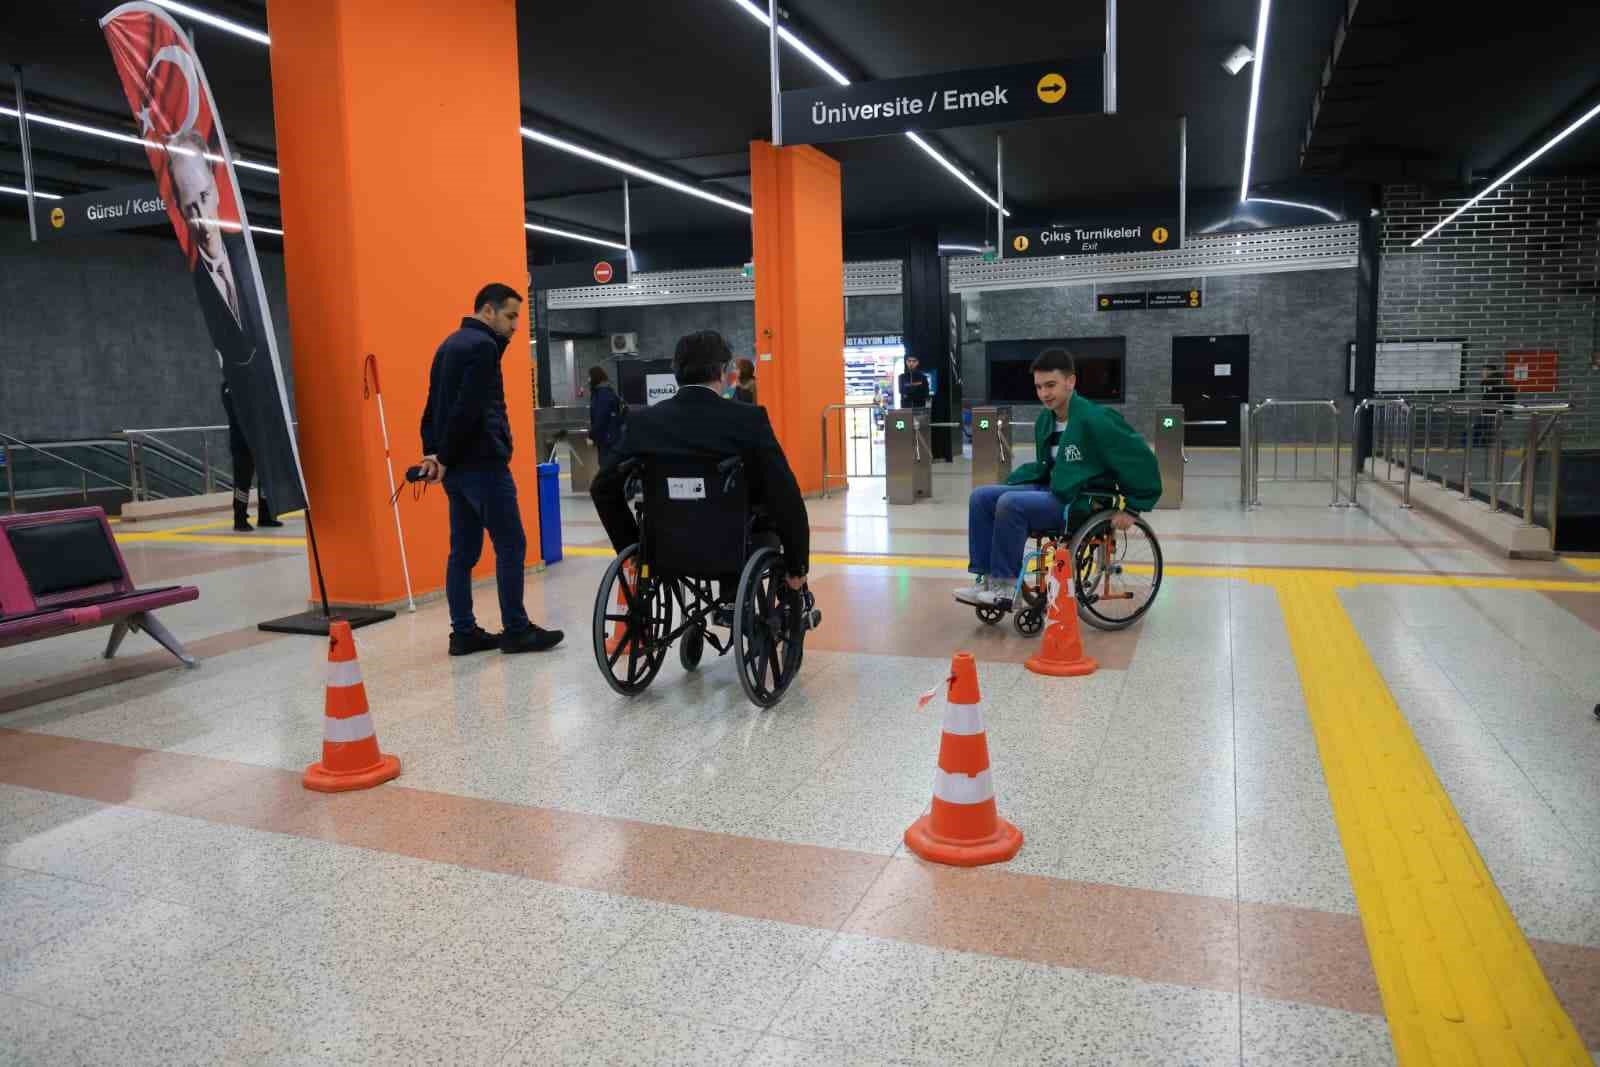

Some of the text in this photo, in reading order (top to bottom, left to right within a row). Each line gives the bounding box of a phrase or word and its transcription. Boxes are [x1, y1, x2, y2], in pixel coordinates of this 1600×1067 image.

[811, 85, 1009, 125] Üniversite / Emek
[87, 204, 123, 220] Gürsu
[125, 199, 130, 215] /
[1040, 225, 1141, 245] Çıkış Turnikeleri
[1081, 242, 1098, 251] Exit
